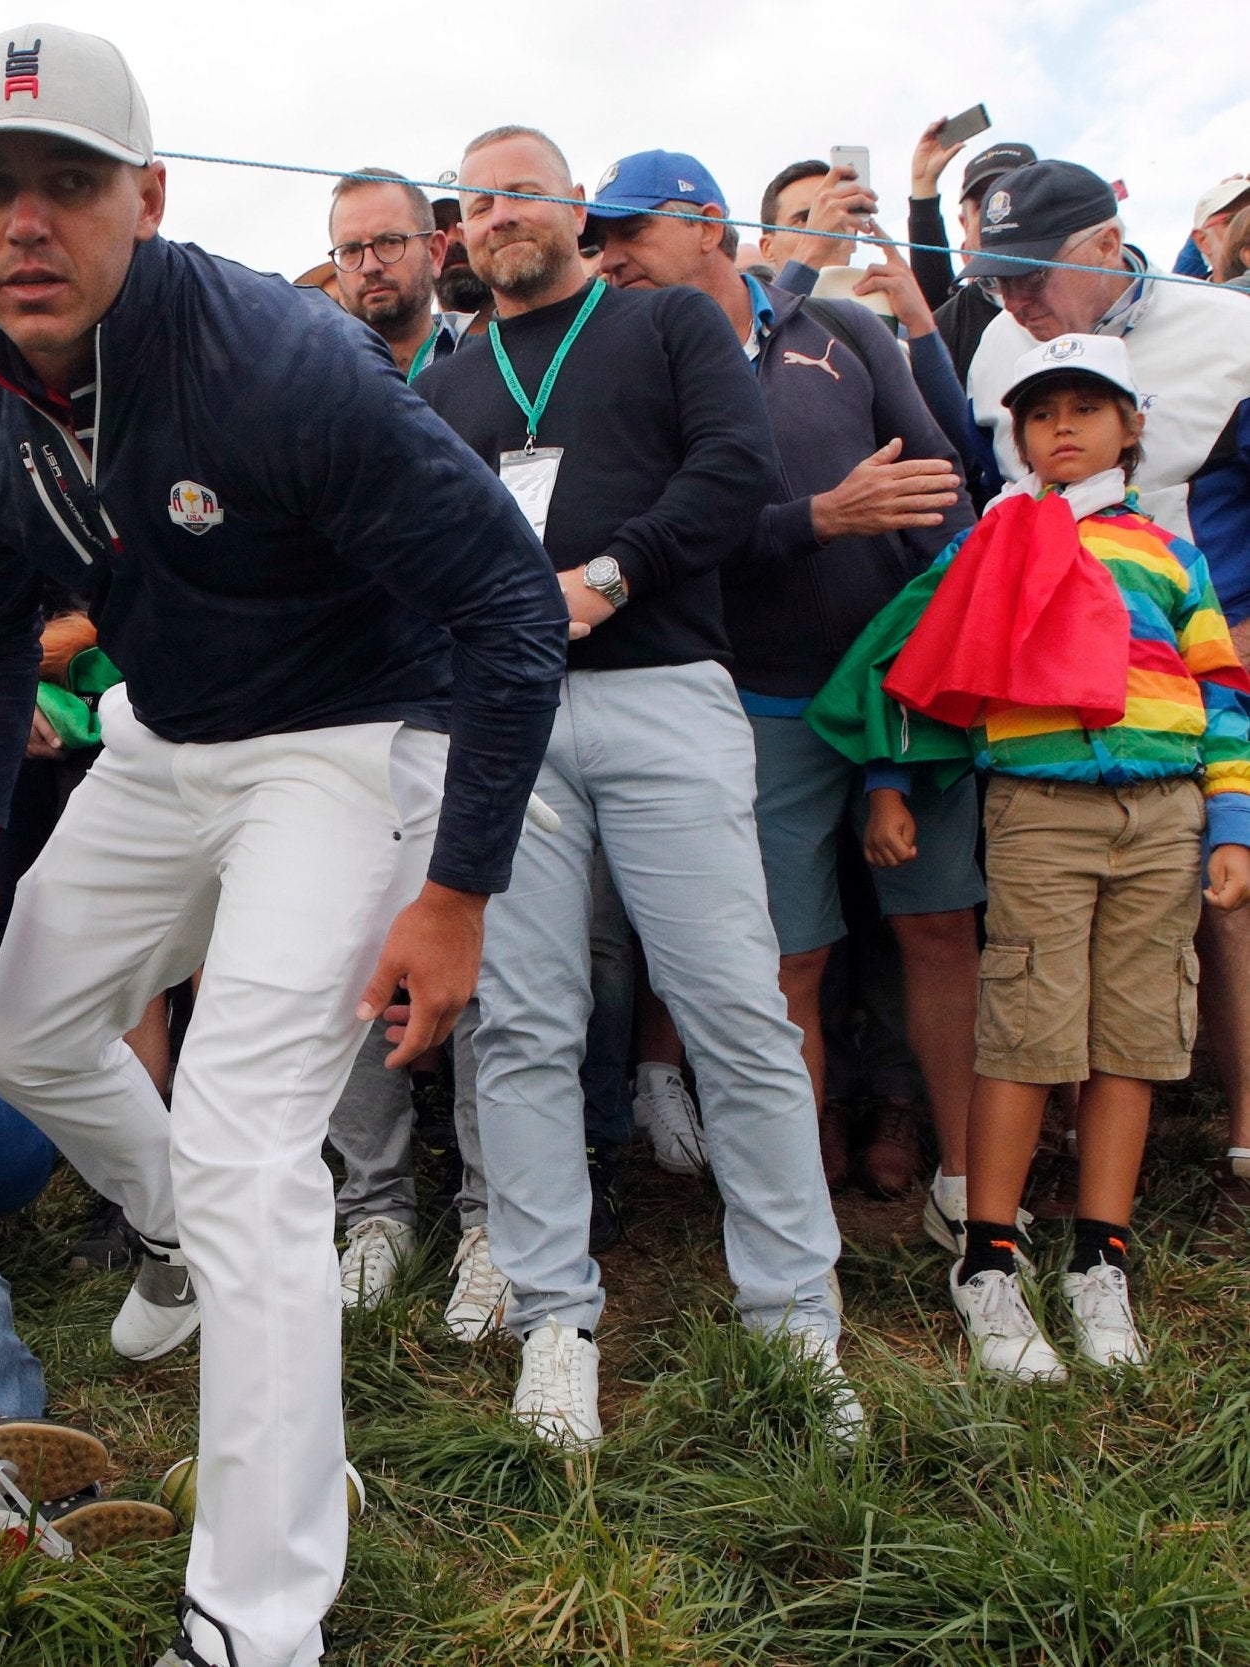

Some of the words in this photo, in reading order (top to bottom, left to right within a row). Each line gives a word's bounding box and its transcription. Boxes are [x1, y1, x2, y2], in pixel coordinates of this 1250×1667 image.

[5, 38, 41, 101] USA
[543, 368, 556, 389] RYDER
[42, 444, 63, 478] USA
